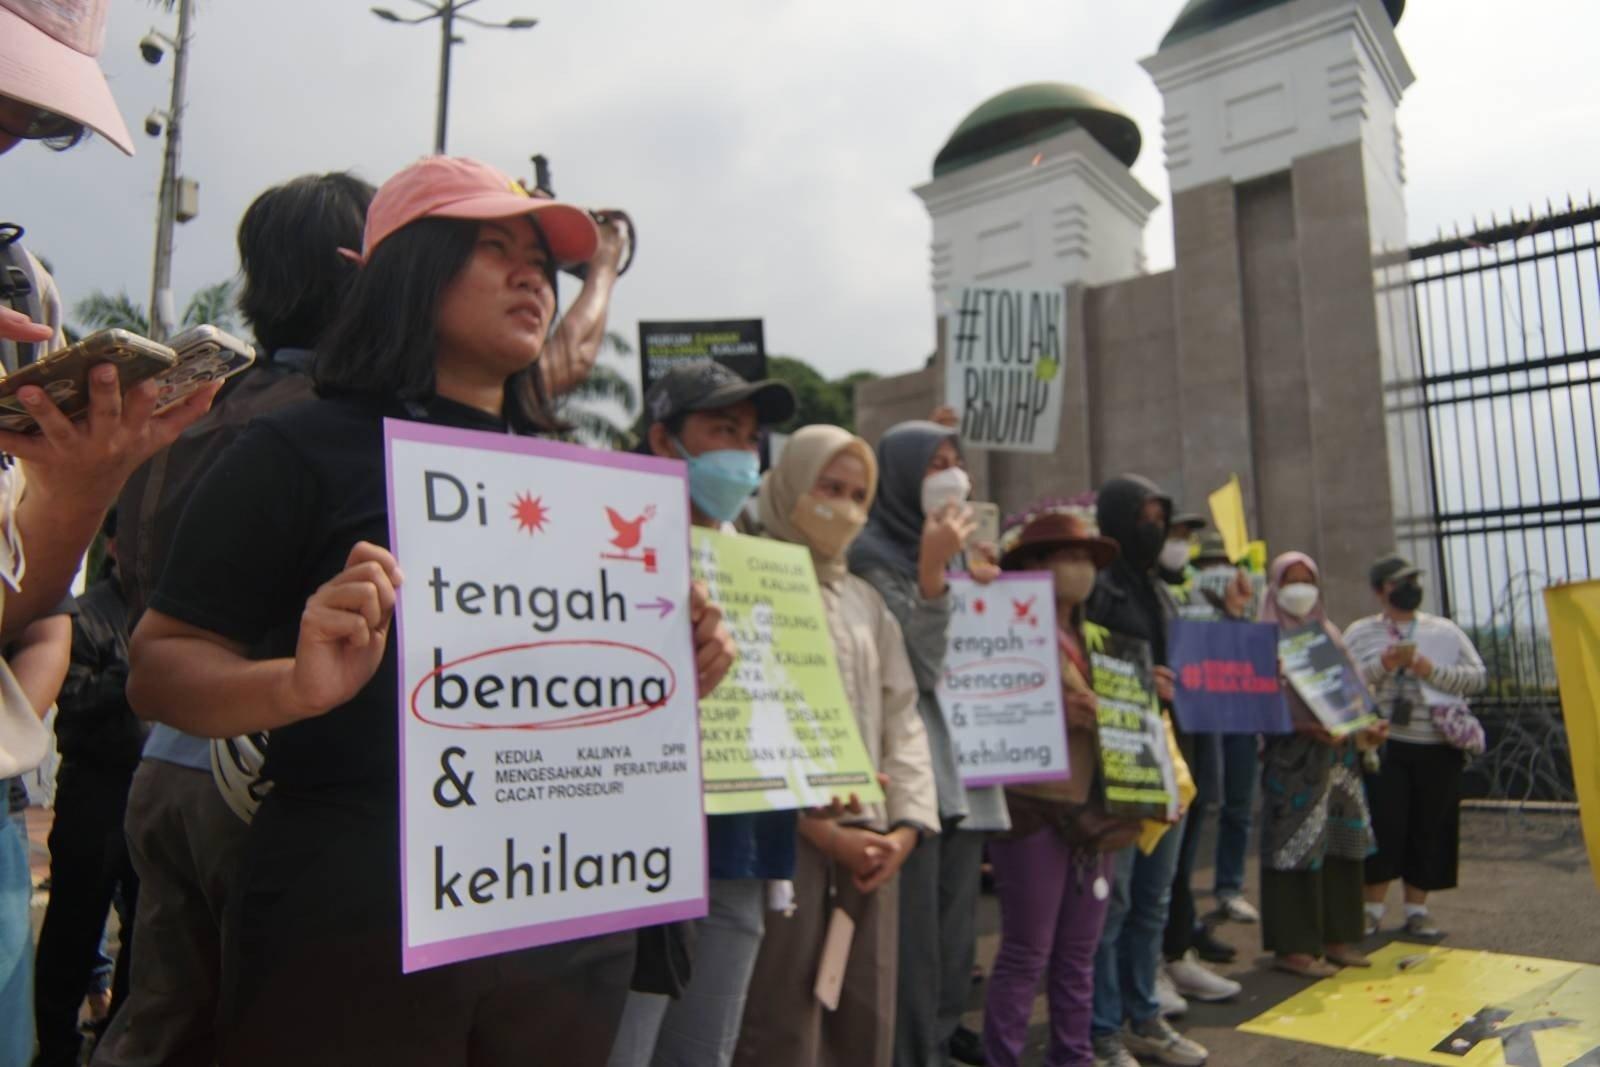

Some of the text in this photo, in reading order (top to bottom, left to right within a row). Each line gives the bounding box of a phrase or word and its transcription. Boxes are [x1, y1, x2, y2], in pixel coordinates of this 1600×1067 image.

[955, 288, 1061, 365] #TOLAK
[424, 470, 488, 526] Di
[429, 566, 627, 633] tengah
[953, 625, 1024, 657] engah
[433, 647, 667, 710] bencana
[432, 746, 477, 808] &
[495, 743, 687, 765] KEDUA KALINYA DPR
[495, 761, 688, 783] MENGESAHKAN PERATURAN
[495, 781, 624, 803] CACAT PROSEDUR!
[434, 832, 673, 910] kehilang
